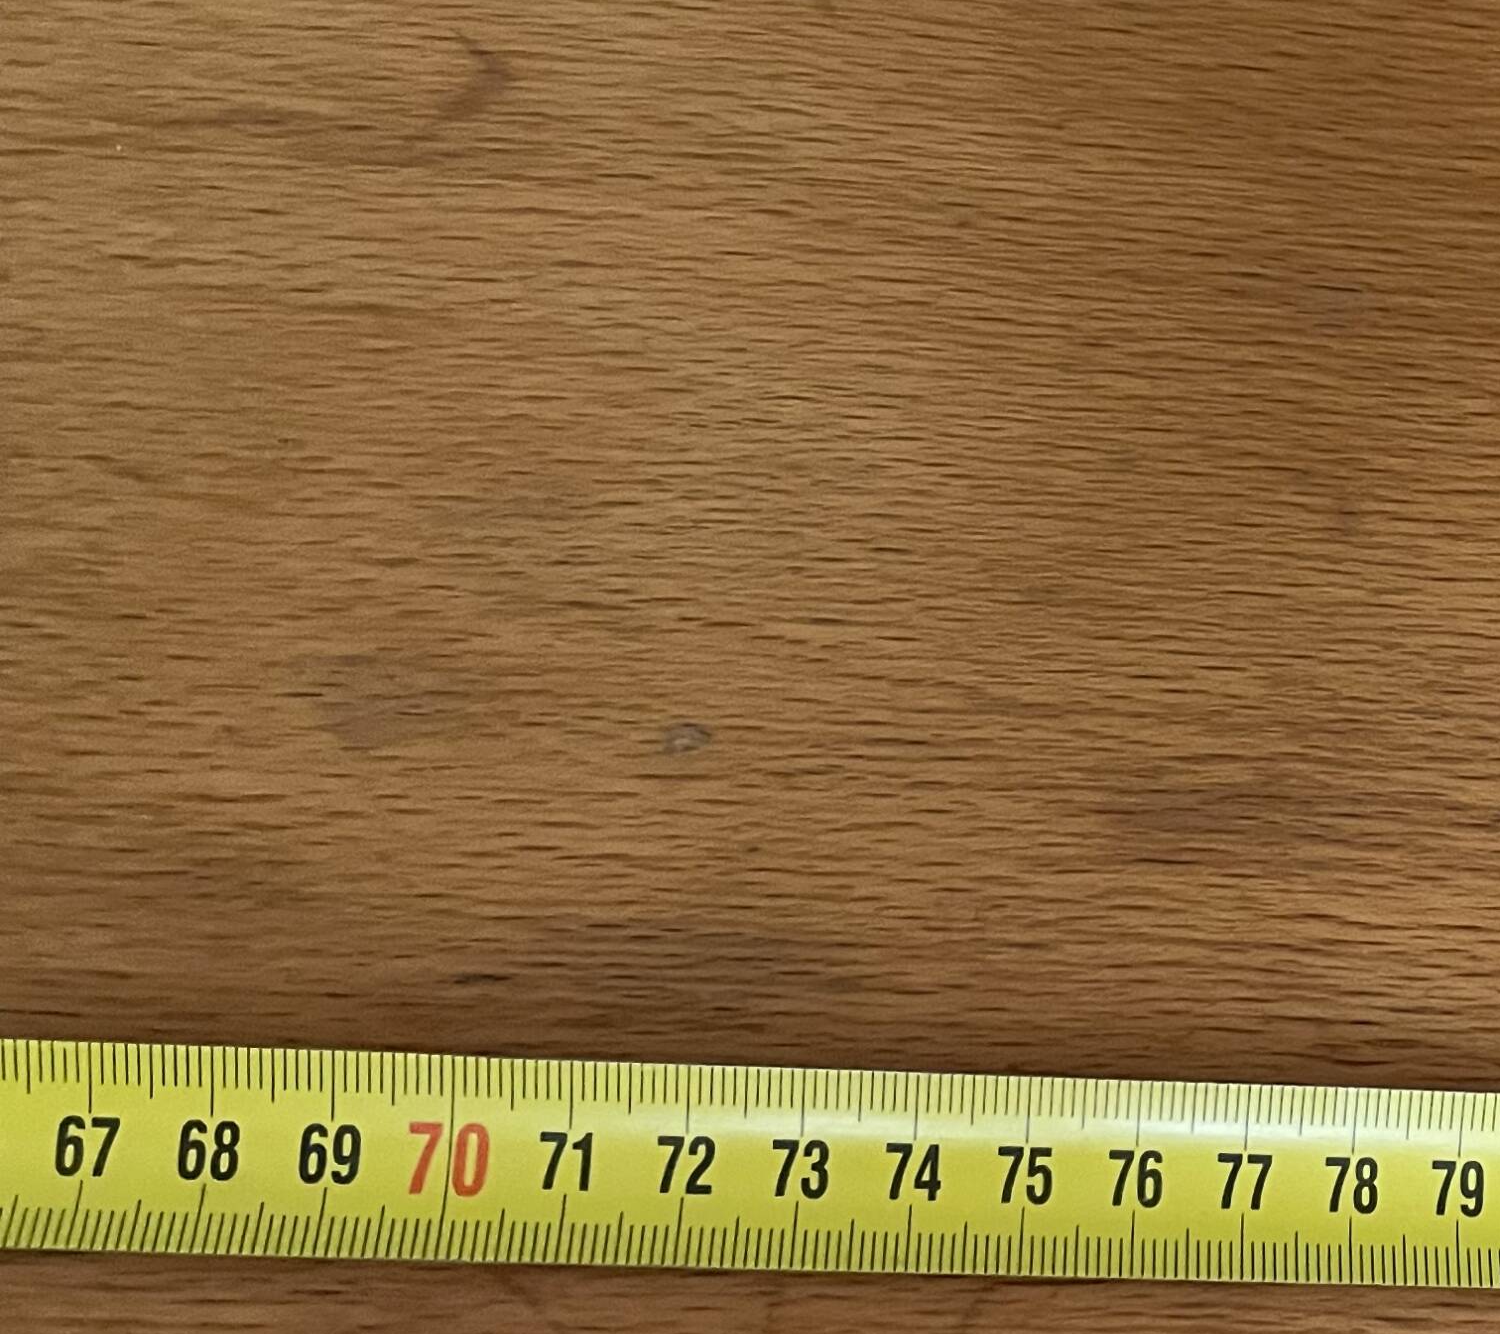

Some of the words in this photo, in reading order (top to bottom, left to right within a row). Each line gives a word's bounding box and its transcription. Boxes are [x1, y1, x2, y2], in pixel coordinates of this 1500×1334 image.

[54, 1115, 121, 1177] 67
[177, 1119, 241, 1181] 68
[298, 1123, 362, 1185] 69
[407, 1121, 490, 1197] 70
[539, 1131, 594, 1192] 71
[656, 1135, 716, 1196] 72
[771, 1139, 829, 1200] 73
[885, 1142, 942, 1202] 74
[997, 1145, 1054, 1205] 75
[1108, 1149, 1163, 1208] 76
[1216, 1153, 1273, 1211] 77
[1325, 1156, 1379, 1214] 78
[1431, 1159, 1486, 1218] 79
